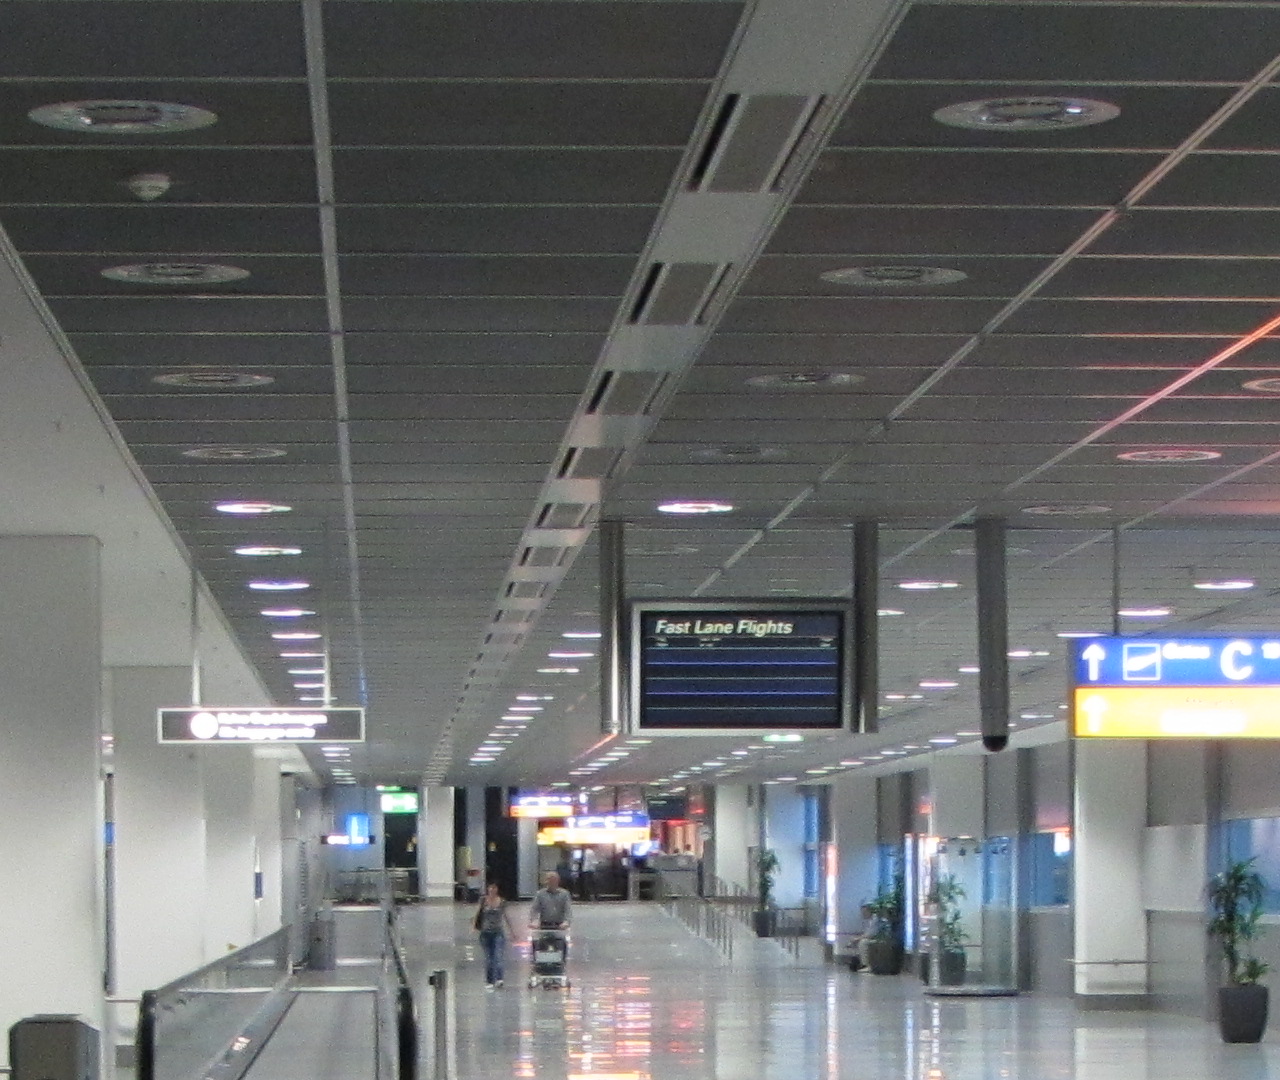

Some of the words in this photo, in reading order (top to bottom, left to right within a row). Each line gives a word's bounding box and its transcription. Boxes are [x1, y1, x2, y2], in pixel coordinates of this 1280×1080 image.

[655, 620, 691, 634] Fast
[694, 620, 734, 634] Lane
[737, 619, 795, 637] Flights
[1220, 641, 1253, 681] C
